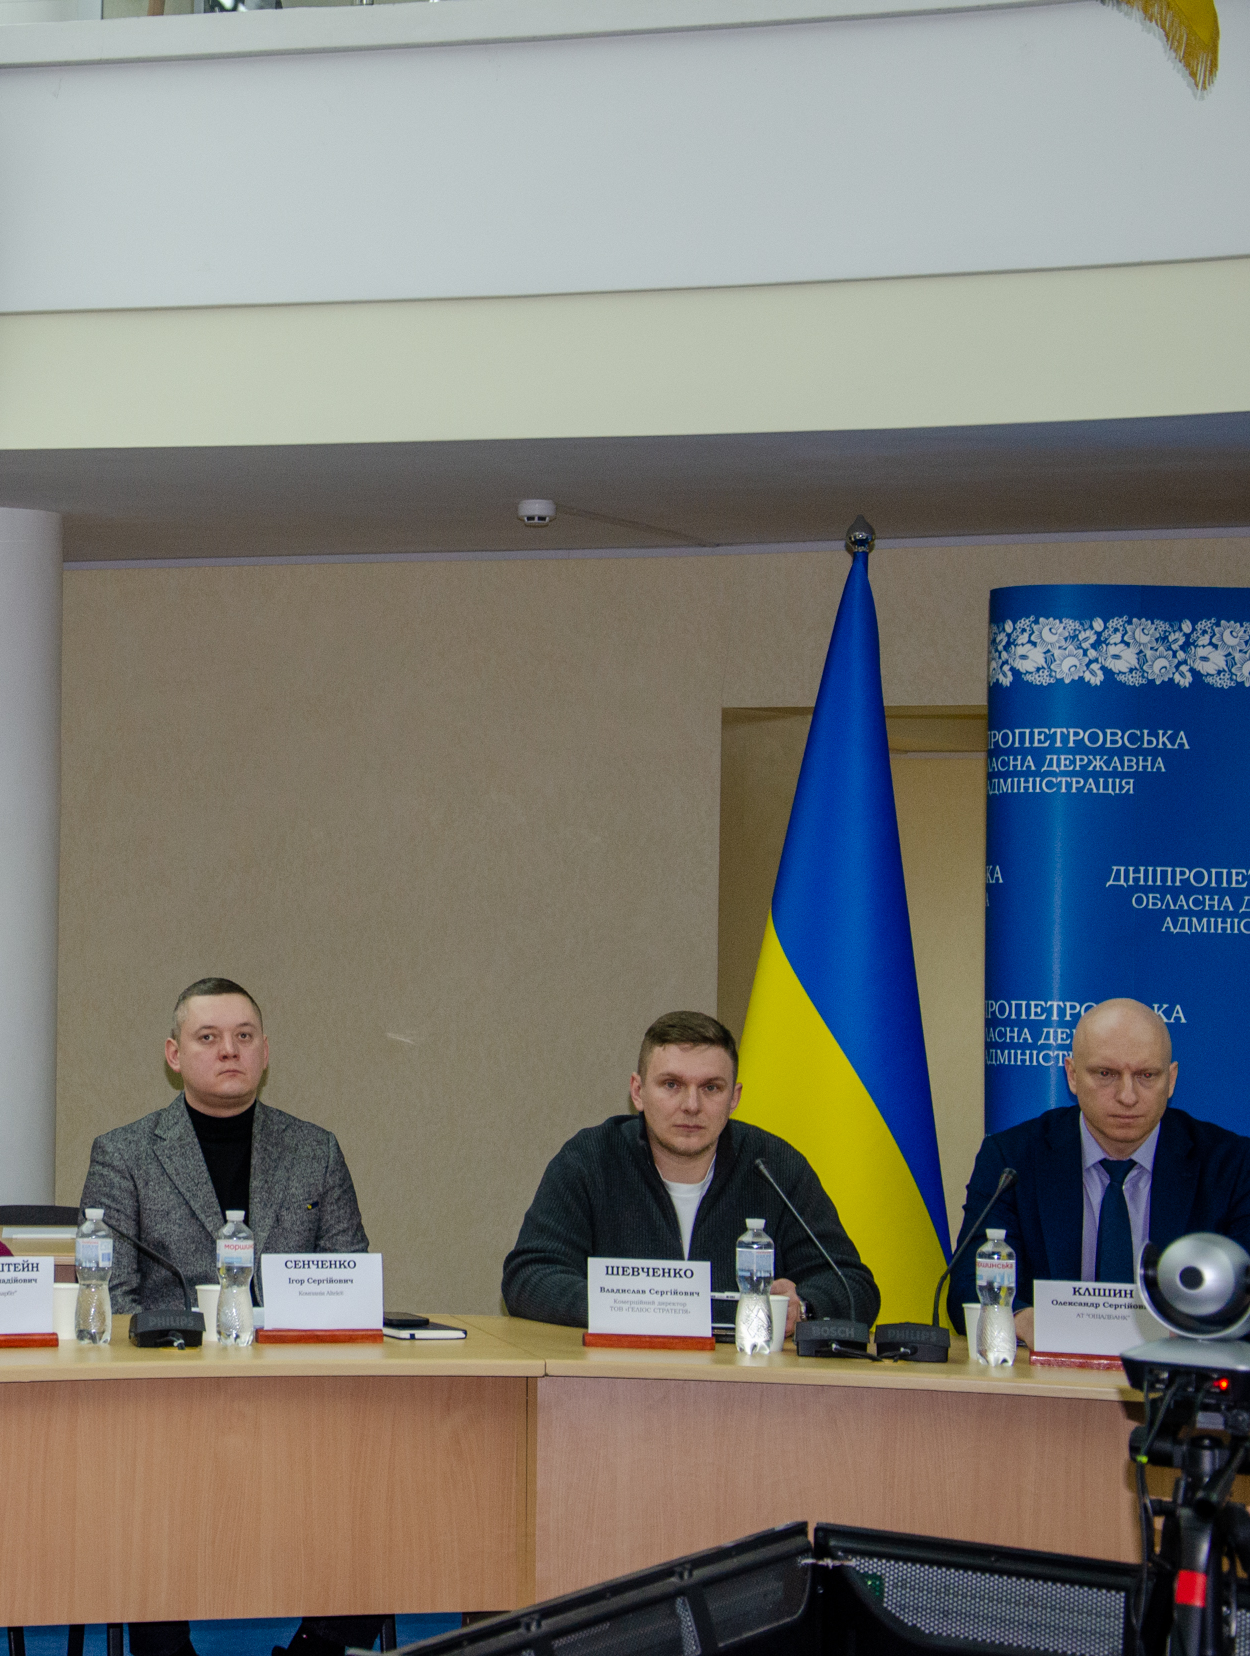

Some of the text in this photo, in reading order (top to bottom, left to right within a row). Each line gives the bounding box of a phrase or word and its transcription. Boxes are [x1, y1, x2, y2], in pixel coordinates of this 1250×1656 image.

[1041, 755, 1166, 773] ДЕРЖАВНА
[1106, 866, 1250, 888] ДНІПРОПЕ
[1132, 893, 1234, 912] ОБЛАСНА
[284, 1259, 357, 1269] СЕНЧЕНКО
[605, 1265, 695, 1279] ШЕВЧЕНКО
[288, 1277, 354, 1286] Ігор Сергійович
[599, 1286, 700, 1297] Владислав Сергійович
[1051, 1299, 1100, 1309] Олександр
[148, 1315, 194, 1327] PHILIPS
[811, 1326, 855, 1338] BOSCH
[887, 1329, 937, 1341] PHILIPS
